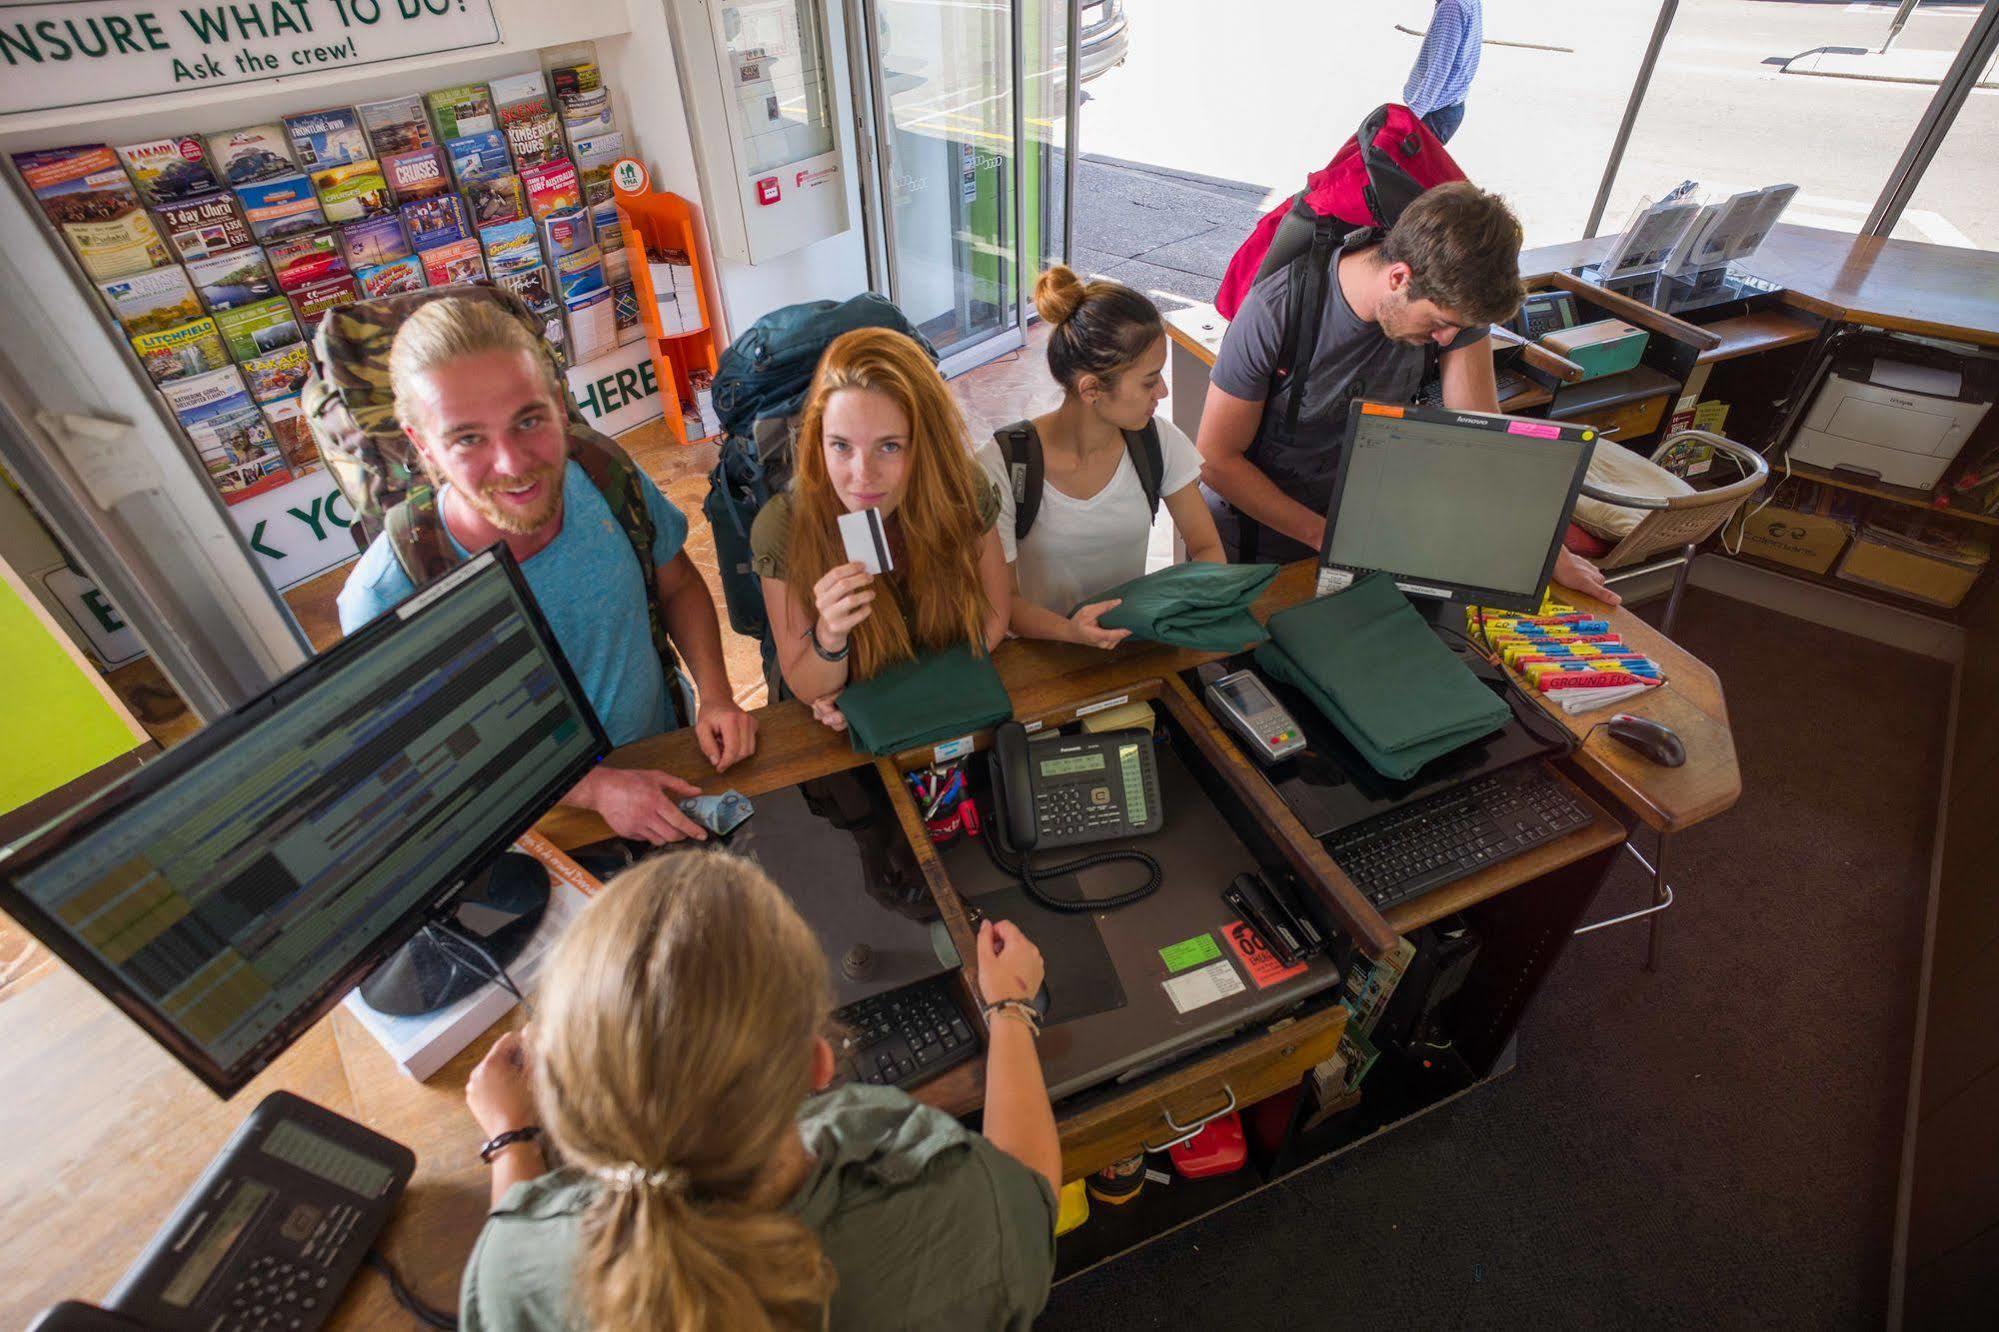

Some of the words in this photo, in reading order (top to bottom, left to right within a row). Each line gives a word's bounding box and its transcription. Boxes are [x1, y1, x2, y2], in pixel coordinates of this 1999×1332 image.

[180, 0, 313, 44] WHAT
[172, 53, 226, 83] Ask
[235, 48, 279, 73] the
[292, 36, 358, 66] crew!
[507, 117, 559, 143] KIMBERLEY
[512, 138, 545, 156] TOURS
[394, 160, 439, 185] CRUISES
[527, 180, 546, 194] SURF
[166, 212, 178, 226] 3
[178, 208, 199, 224] day
[200, 202, 232, 219] Uluru
[142, 321, 212, 347] LITCHFIELD
[244, 346, 309, 371] KAKADU
[571, 359, 658, 418] HERE
[1456, 415, 1489, 425] lenovo
[1550, 674, 1606, 688] GROUND
